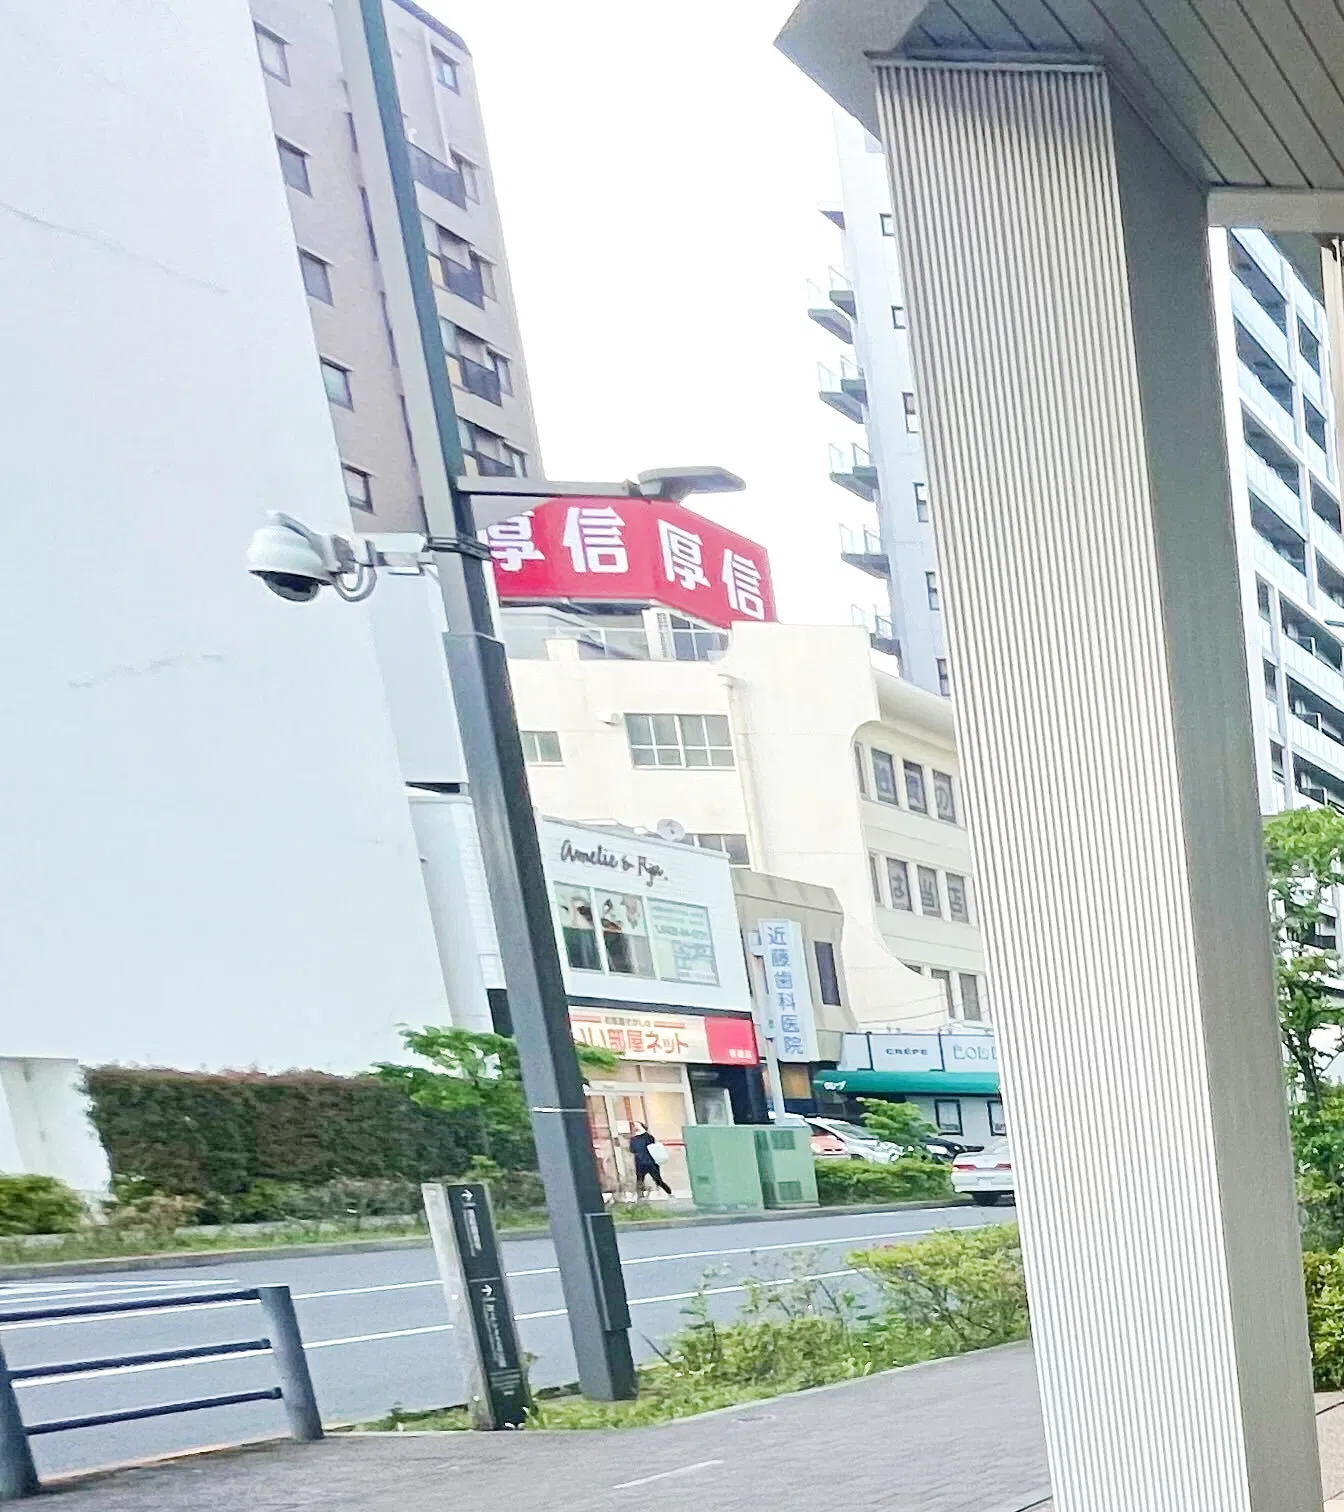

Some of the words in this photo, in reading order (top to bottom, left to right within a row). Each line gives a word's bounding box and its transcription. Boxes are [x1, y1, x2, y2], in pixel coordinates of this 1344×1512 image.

[768, 925, 804, 1056] 近藤歯科医院
